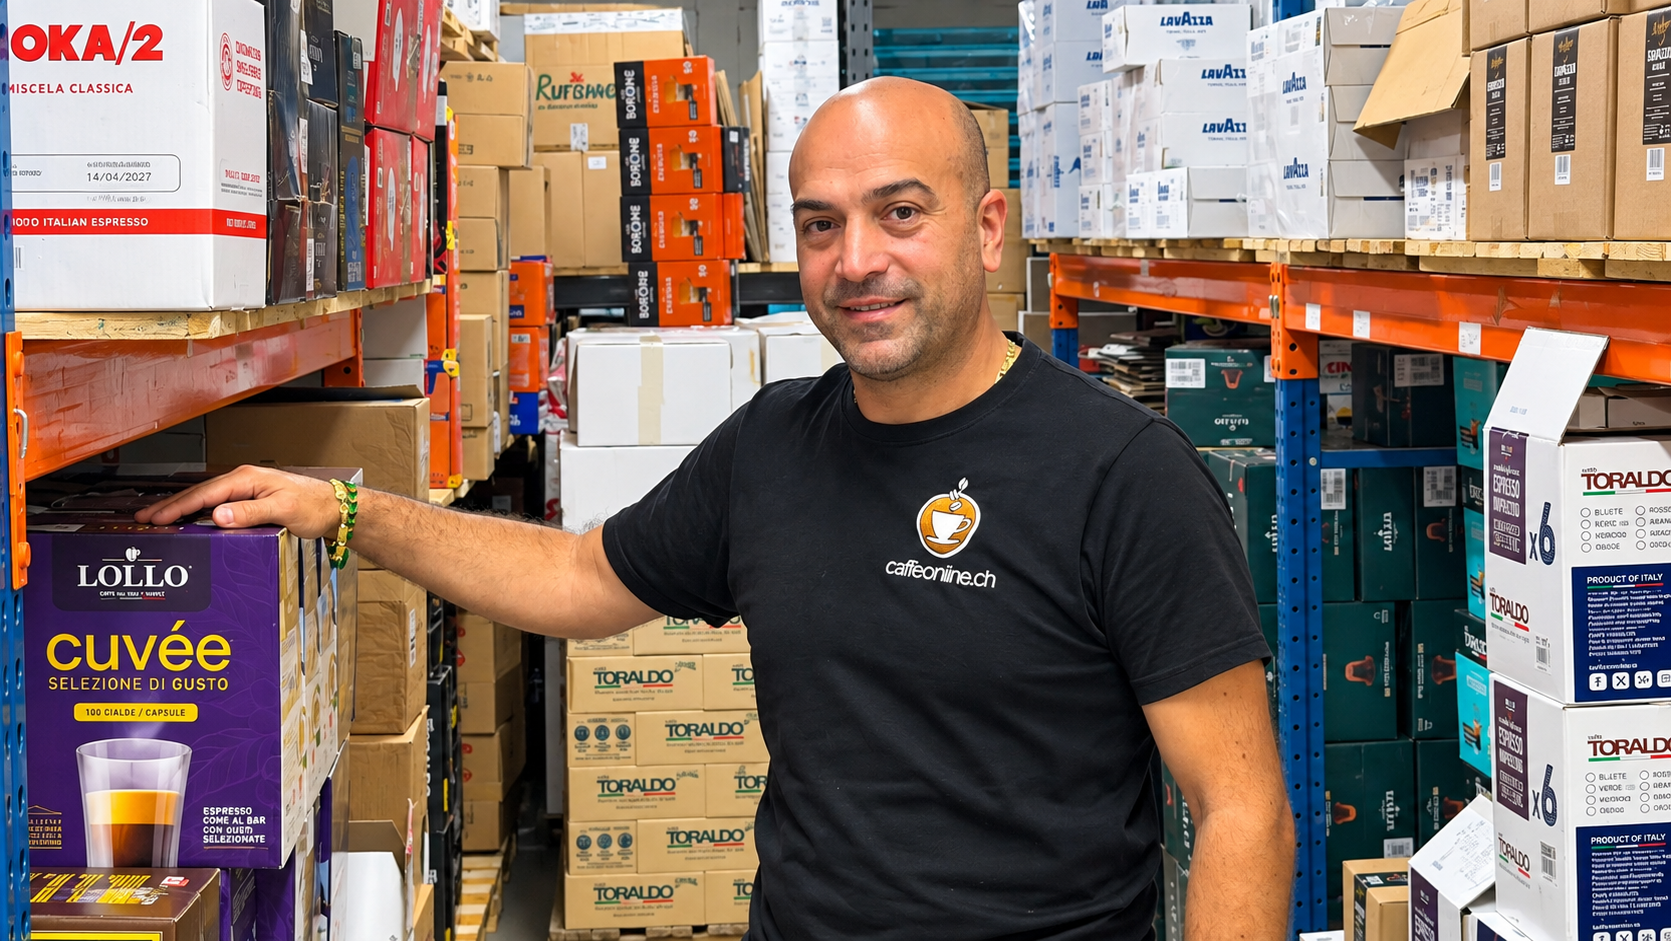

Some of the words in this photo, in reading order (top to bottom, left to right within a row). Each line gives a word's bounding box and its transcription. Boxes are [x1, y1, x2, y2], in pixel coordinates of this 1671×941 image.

[11, 21, 163, 65] OKA/2
[10, 83, 64, 94] MISCELA
[70, 83, 134, 94] CLASSICA
[87, 172, 152, 182] 14/04/2027
[43, 217, 87, 227] ITALIAN
[91, 217, 149, 227] ESPRESSO
[77, 564, 190, 588] LOLLO
[1628, 574, 1640, 582] OF
[1641, 573, 1663, 582] ITALY
[46, 619, 231, 672] cuvée
[593, 670, 673, 685] TORALDO
[48, 677, 142, 691] SELEZIONE
[150, 677, 165, 691] DI
[172, 677, 229, 691] GUSTO
[85, 708, 101, 717] 100
[104, 708, 136, 717] CIALDE
[145, 707, 186, 717] CAPSULE
[665, 722, 744, 737] TORALDO
[597, 778, 676, 794] TORALDO
[203, 807, 252, 815] ESPRESSO
[203, 816, 229, 825] COME
[232, 816, 244, 825] AL
[203, 826, 222, 834] CON
[666, 828, 744, 844] TORALDO
[1631, 834, 1643, 843] OF
[1644, 833, 1666, 842] ITALY
[593, 885, 674, 901] TORALDO
